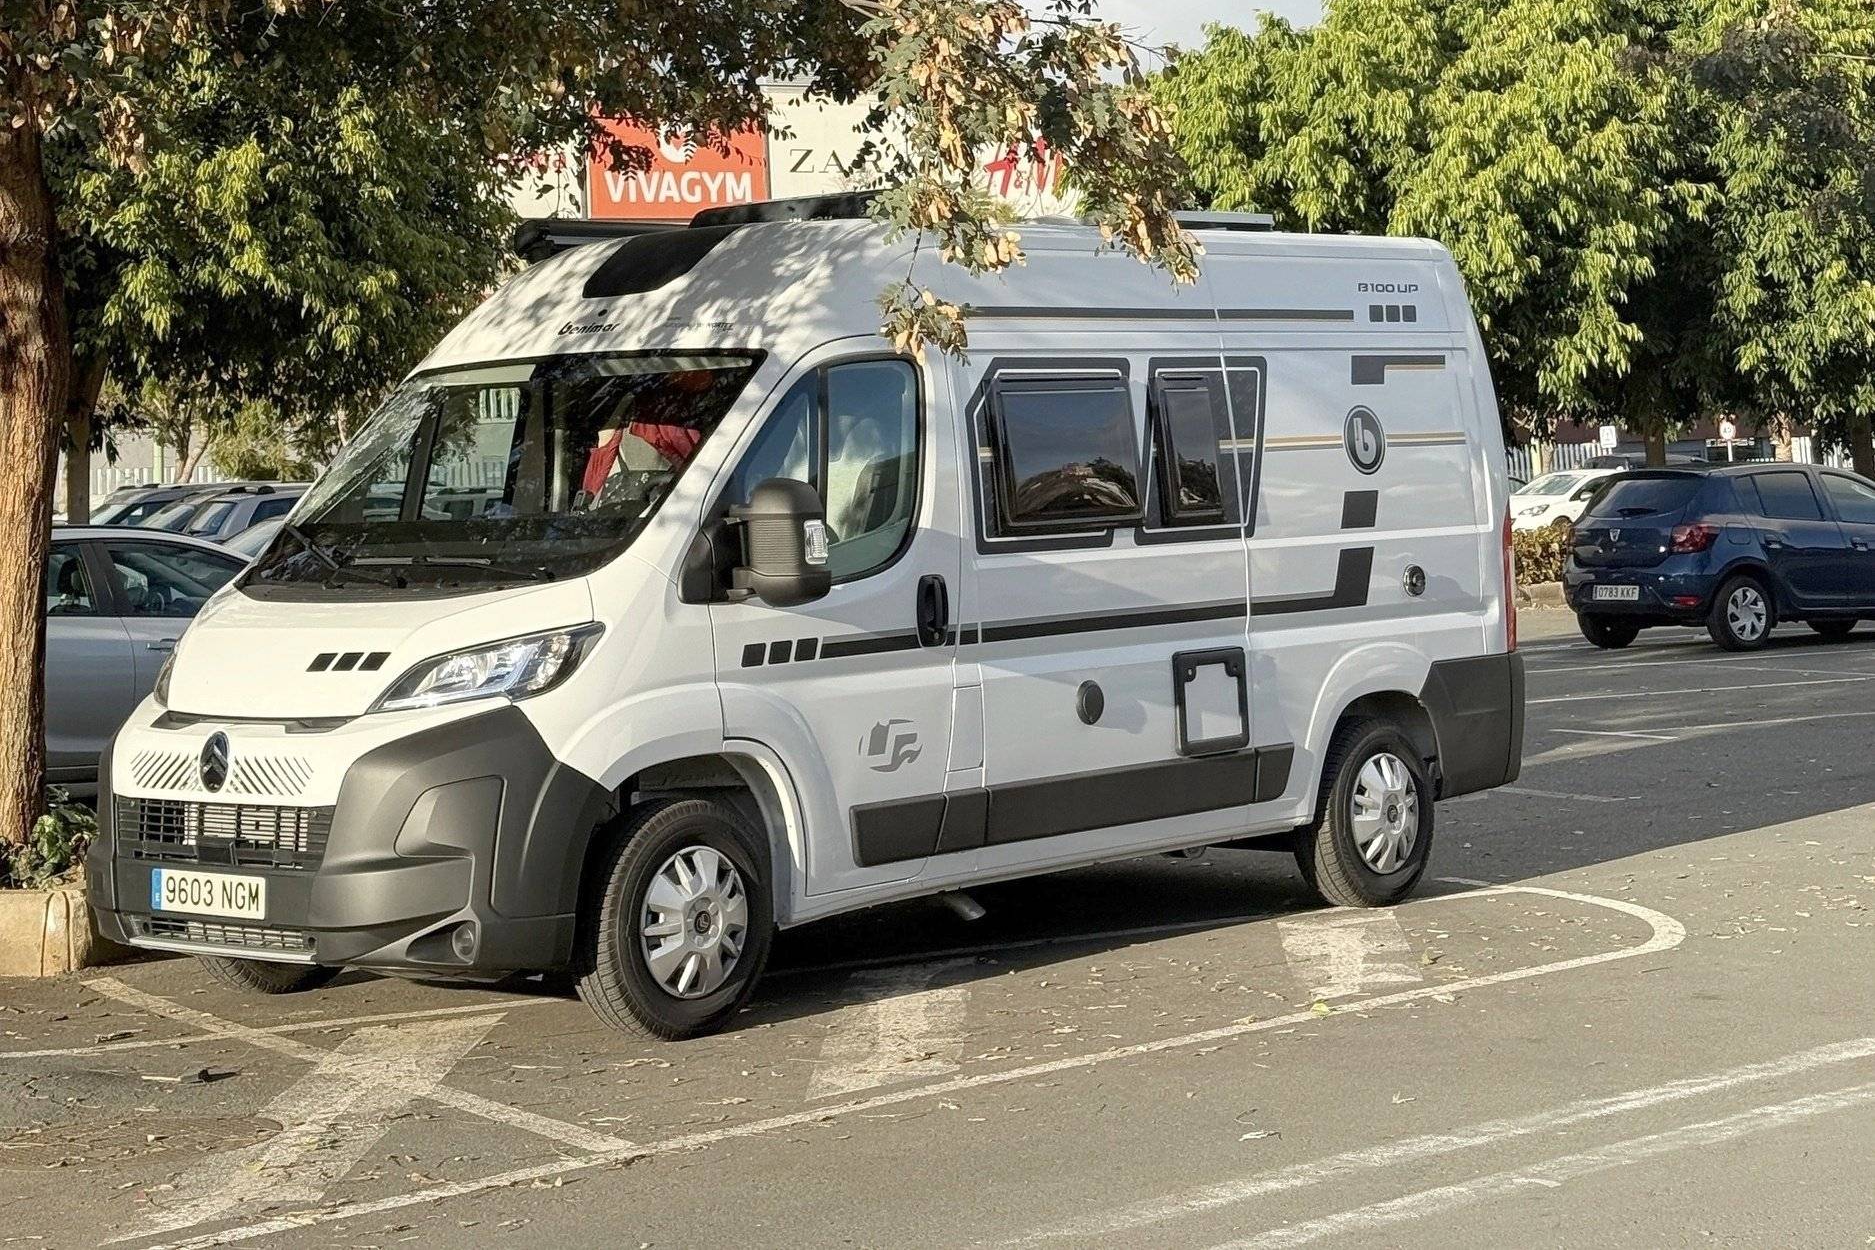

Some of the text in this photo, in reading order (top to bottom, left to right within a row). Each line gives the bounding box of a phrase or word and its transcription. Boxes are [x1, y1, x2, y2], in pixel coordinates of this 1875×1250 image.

[789, 148, 894, 174] ZAR
[1357, 282, 1419, 294] B100 UP
[557, 321, 620, 336] benimar
[1598, 586, 1619, 598] 0783
[166, 876, 259, 911] 9603 NGM
